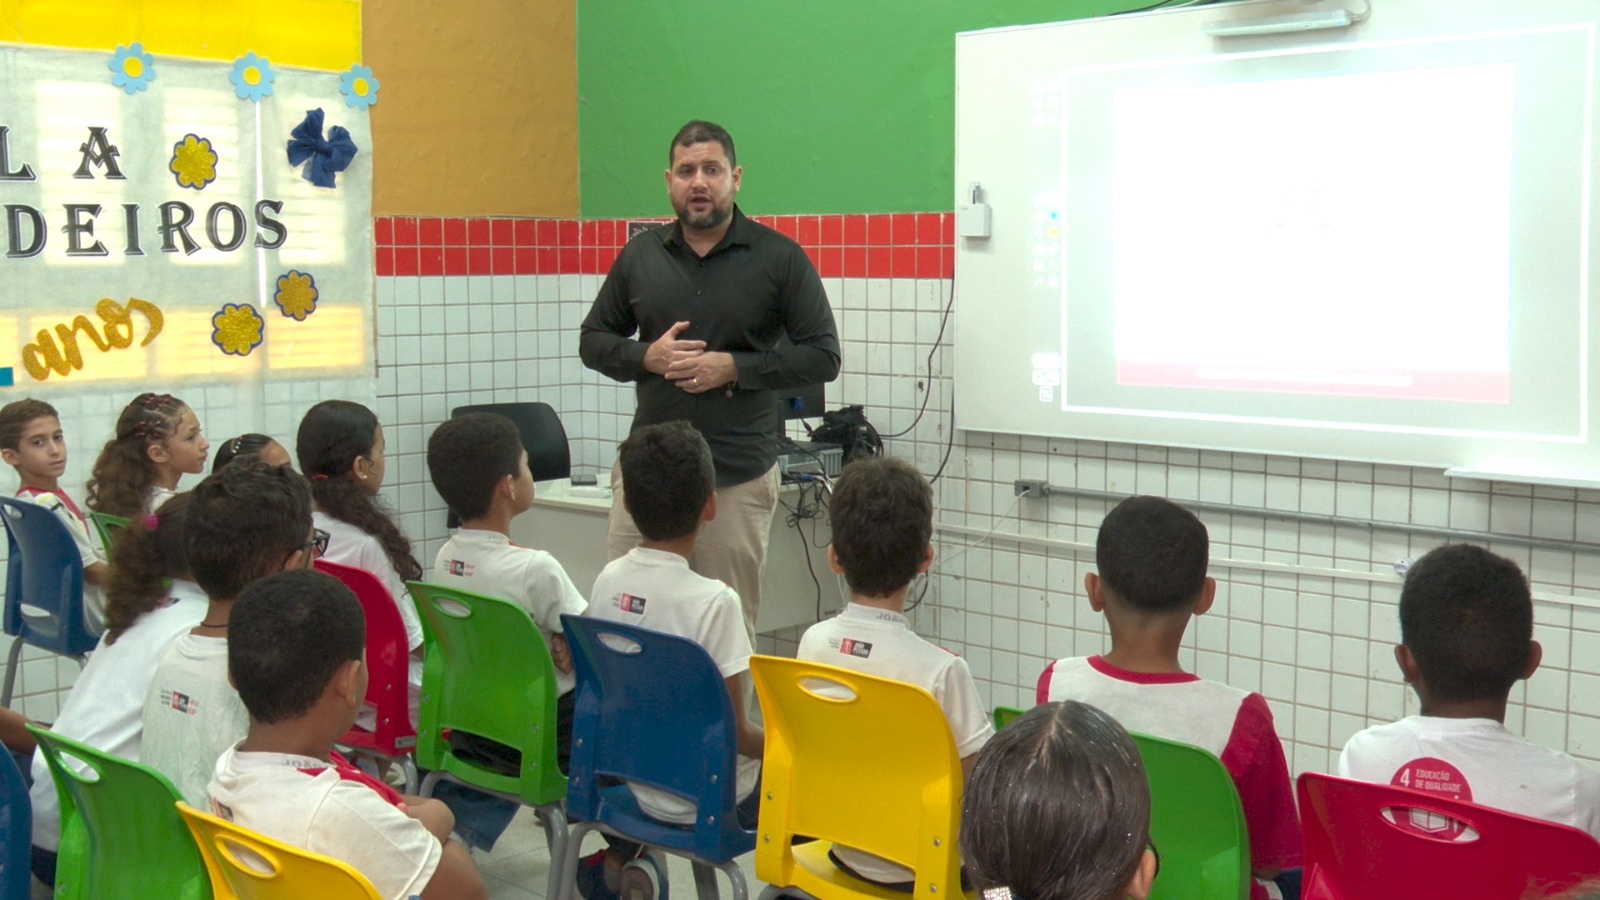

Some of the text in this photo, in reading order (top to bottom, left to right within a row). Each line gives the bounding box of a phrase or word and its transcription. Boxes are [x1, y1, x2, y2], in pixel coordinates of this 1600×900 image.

[4, 199, 287, 258] DEIROS
[1400, 768, 1410, 787] 4
[1415, 779, 1461, 792] DE QUALIDADE
